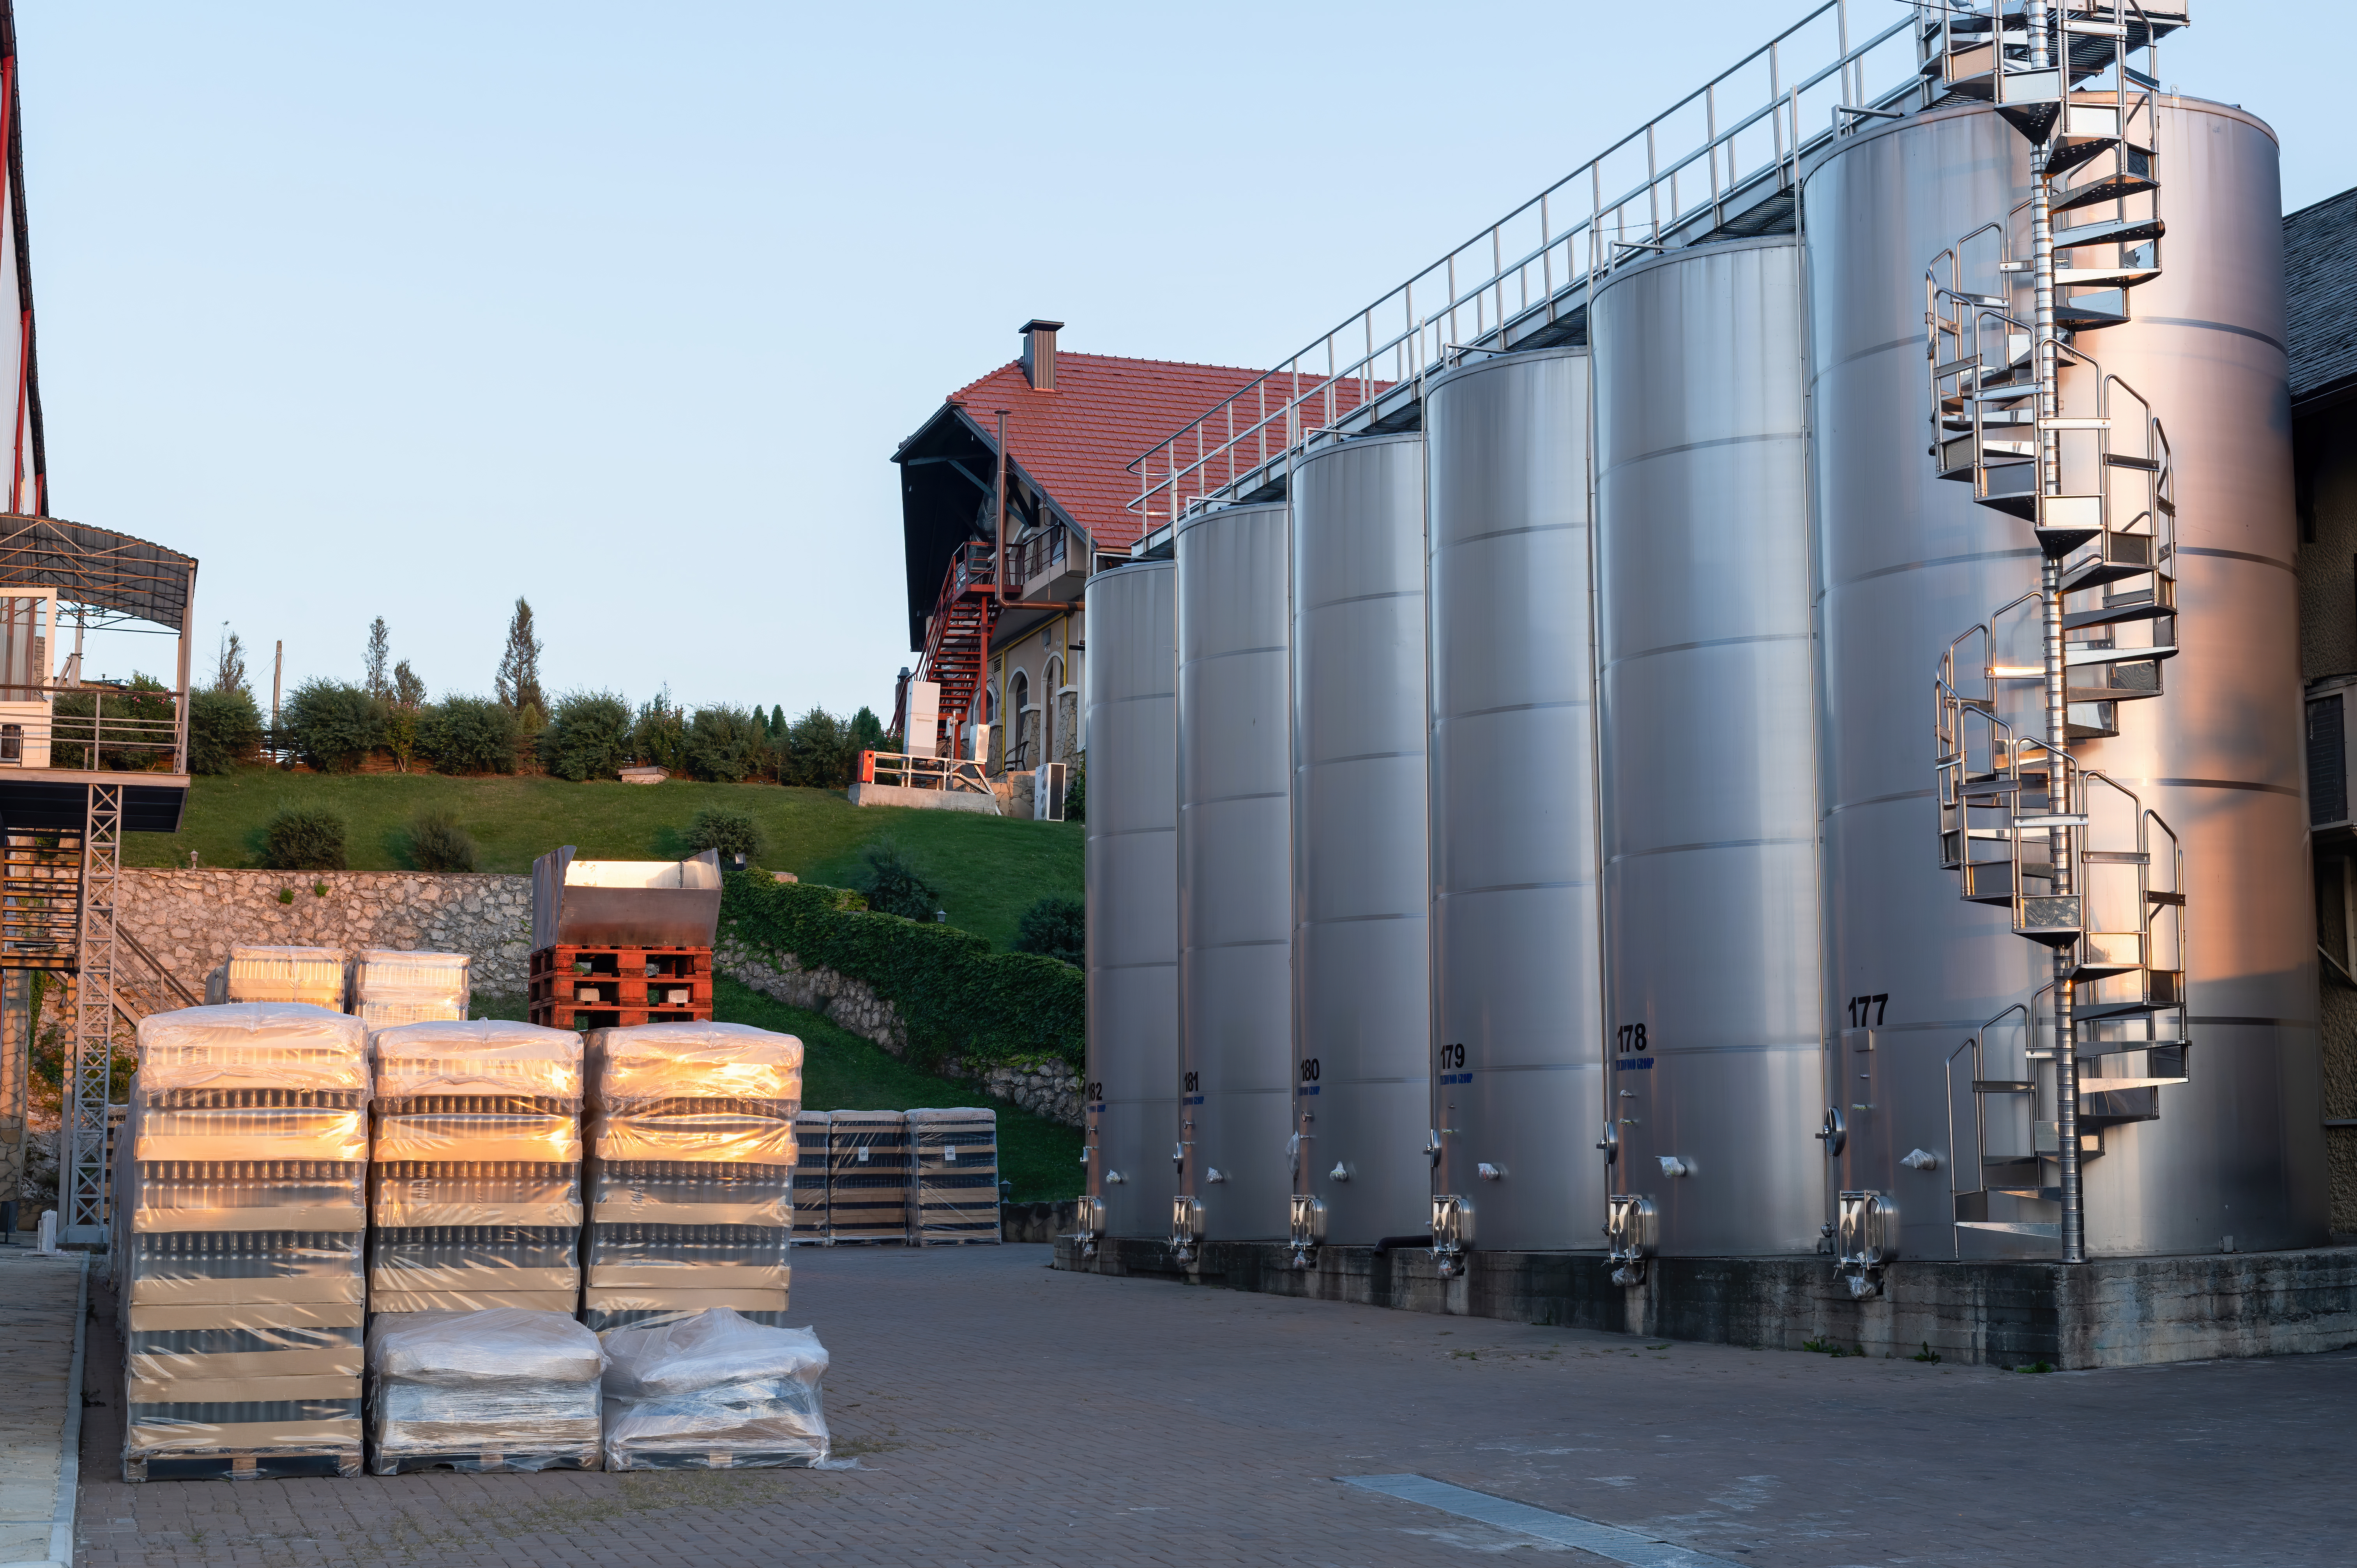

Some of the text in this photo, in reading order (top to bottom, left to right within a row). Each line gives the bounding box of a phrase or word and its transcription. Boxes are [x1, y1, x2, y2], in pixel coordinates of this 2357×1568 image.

[1848, 993, 1888, 1028] 177
[1617, 1023, 1647, 1052] 178
[1441, 1043, 1465, 1069] 179
[1637, 1057, 1654, 1070] GROUP
[1301, 1058, 1320, 1081] 180
[1088, 1082, 1102, 1101] 182
[1184, 1071, 1198, 1092] 181
